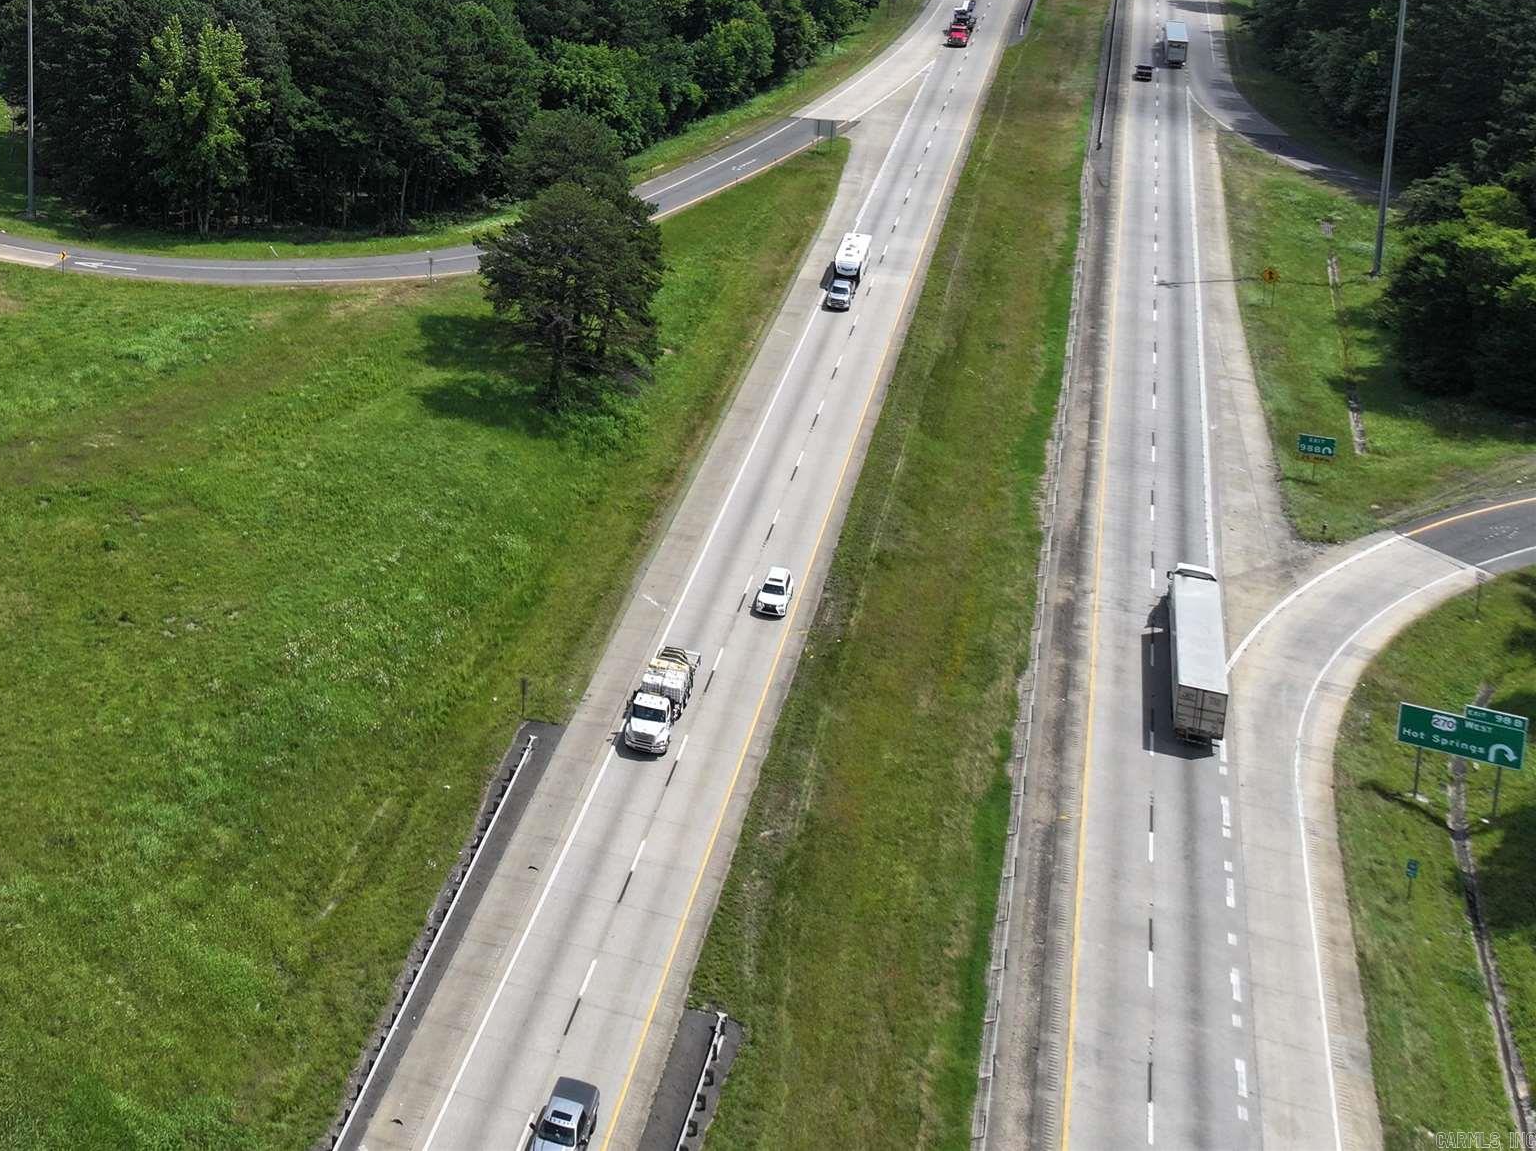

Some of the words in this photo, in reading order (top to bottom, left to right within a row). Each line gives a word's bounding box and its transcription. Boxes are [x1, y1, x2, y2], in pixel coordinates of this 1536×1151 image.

[1432, 717, 1455, 730] 270
[1464, 721, 1493, 733] WEST
[1402, 727, 1426, 740] Hot
[1431, 734, 1486, 754] Springs
